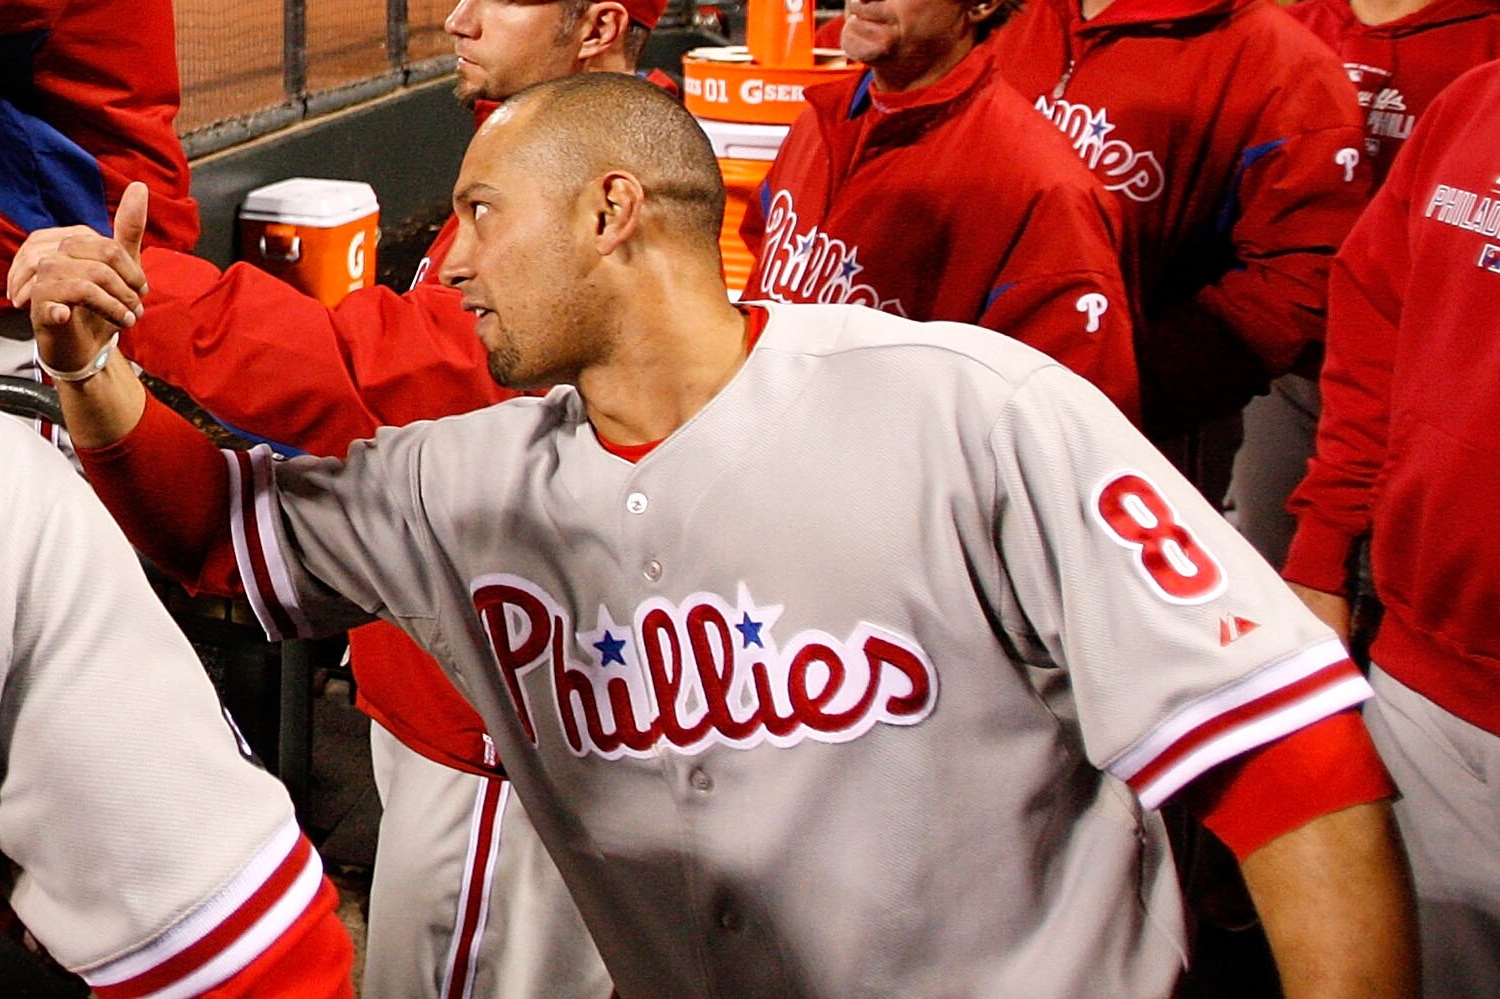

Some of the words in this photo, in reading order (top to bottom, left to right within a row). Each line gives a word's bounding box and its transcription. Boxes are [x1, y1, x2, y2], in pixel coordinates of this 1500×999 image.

[1334, 147, 1360, 183] P
[1424, 183, 1500, 241] PHILAD
[347, 230, 366, 280] G
[1075, 293, 1109, 333] P
[1091, 468, 1229, 606] 8
[469, 572, 941, 762] Phillies
